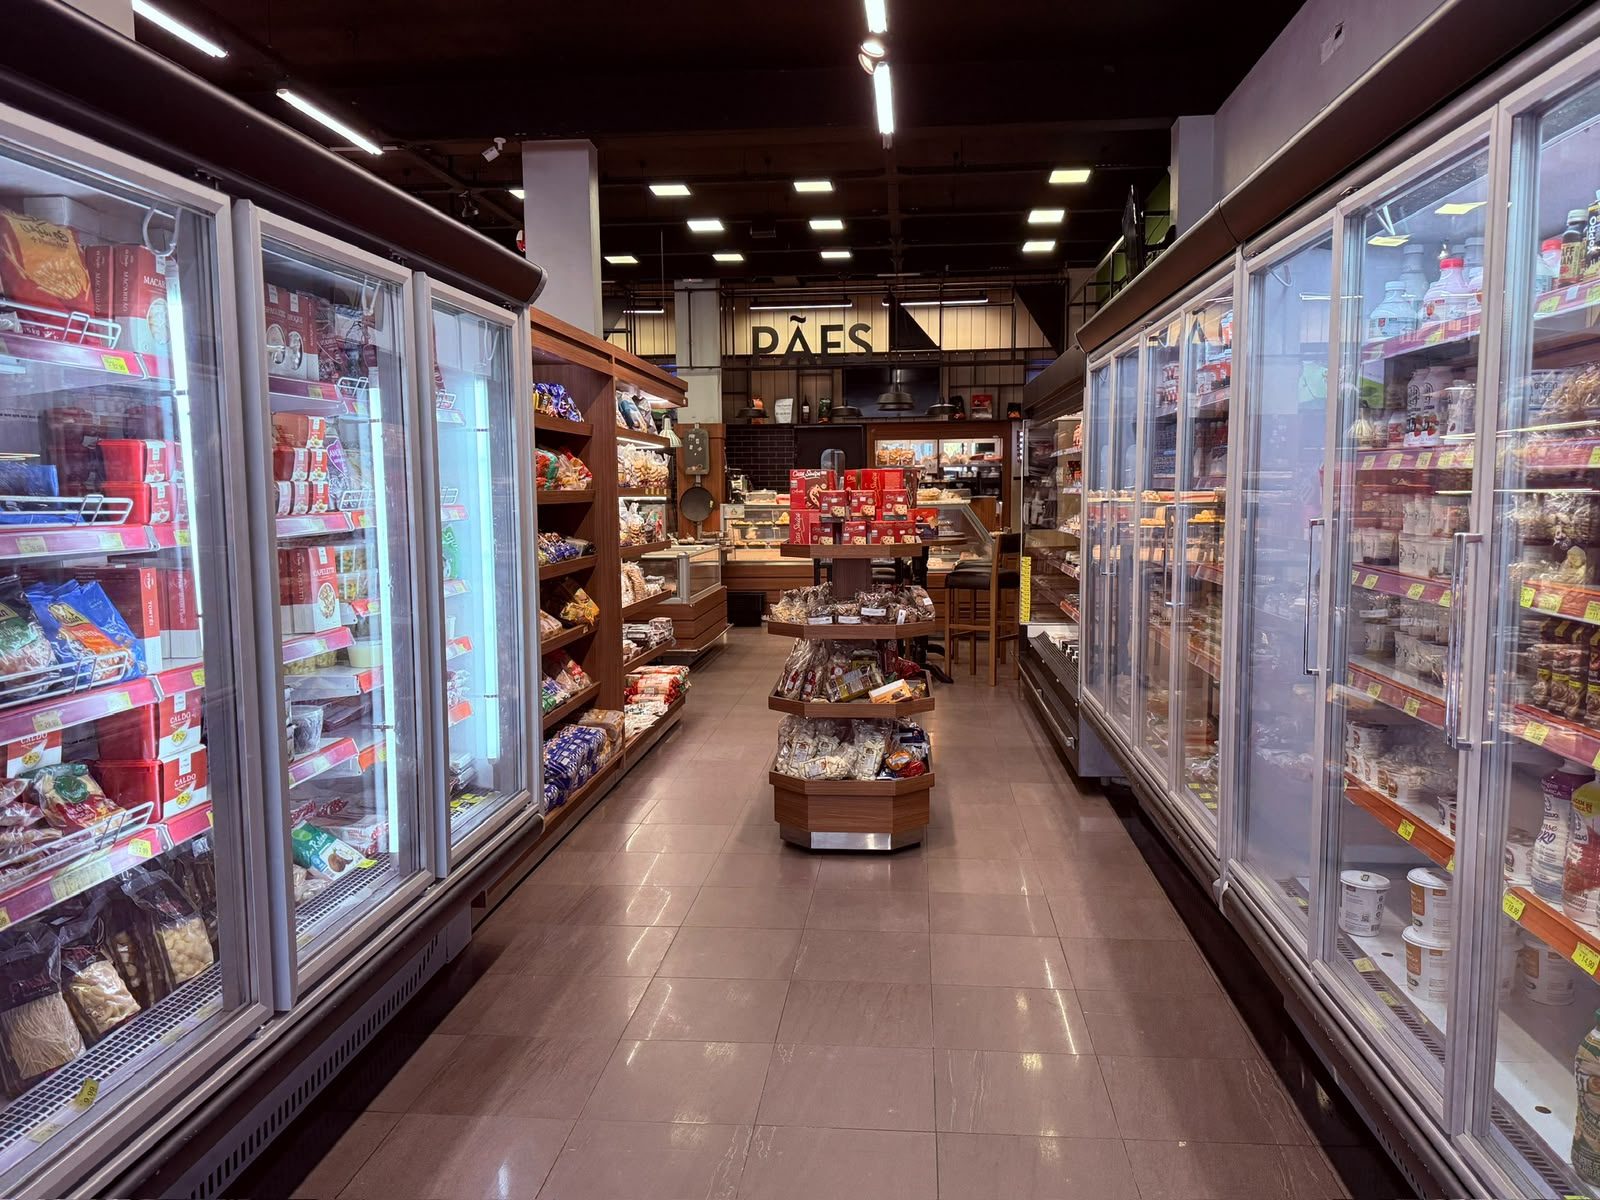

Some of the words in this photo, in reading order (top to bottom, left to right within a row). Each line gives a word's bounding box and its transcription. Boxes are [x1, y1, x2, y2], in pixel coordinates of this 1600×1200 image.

[751, 315, 873, 365] PÃES
[169, 711, 191, 724] CALDO
[174, 774, 197, 787] CALDO
